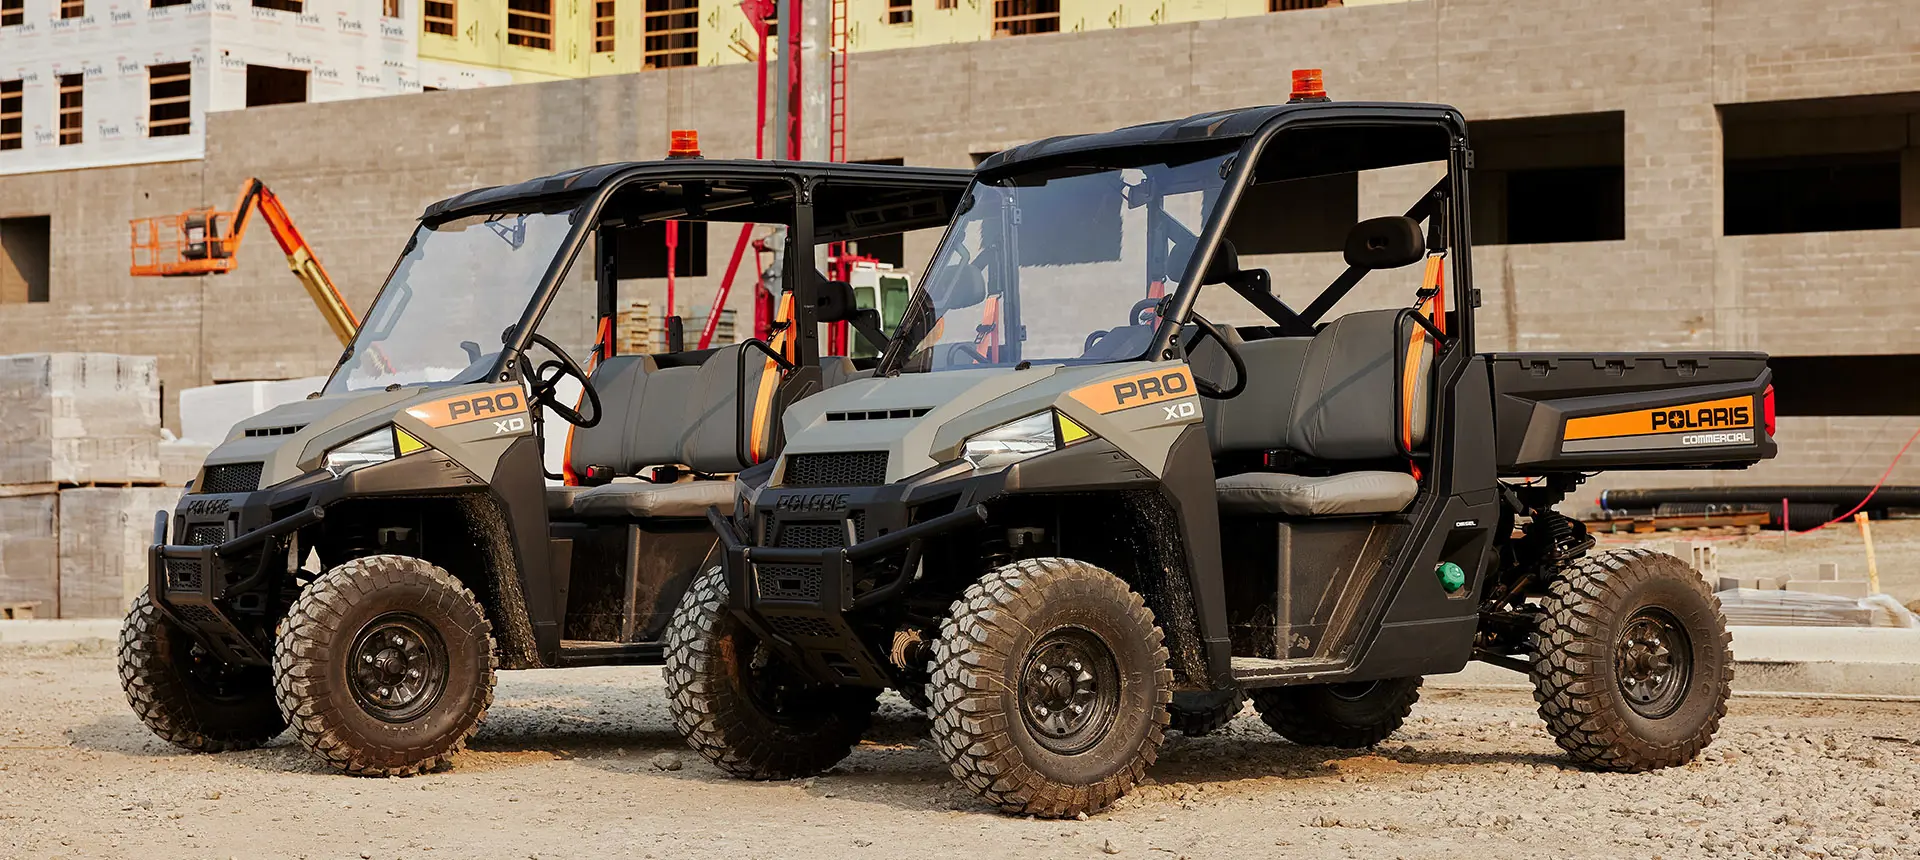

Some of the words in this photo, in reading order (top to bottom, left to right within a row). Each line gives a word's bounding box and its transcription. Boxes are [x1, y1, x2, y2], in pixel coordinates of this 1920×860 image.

[110, 11, 132, 22] Tyvek
[338, 17, 362, 30] Tyvek
[380, 24, 403, 36] Tyvek
[220, 55, 246, 67] Tyvek
[287, 52, 311, 64] Tyvek
[118, 60, 138, 74] Tyvek
[314, 66, 338, 77] Tyvek
[356, 70, 380, 83] Tyvek
[99, 125, 120, 137] Tyvek
[1112, 372, 1188, 405] PRO
[448, 392, 519, 420] PRO
[1162, 402, 1195, 421] XD
[1651, 406, 1749, 431] POLARIS
[493, 417, 525, 434] XD
[1682, 432, 1751, 445] COMMERCIAL
[776, 494, 850, 512] POLARIS
